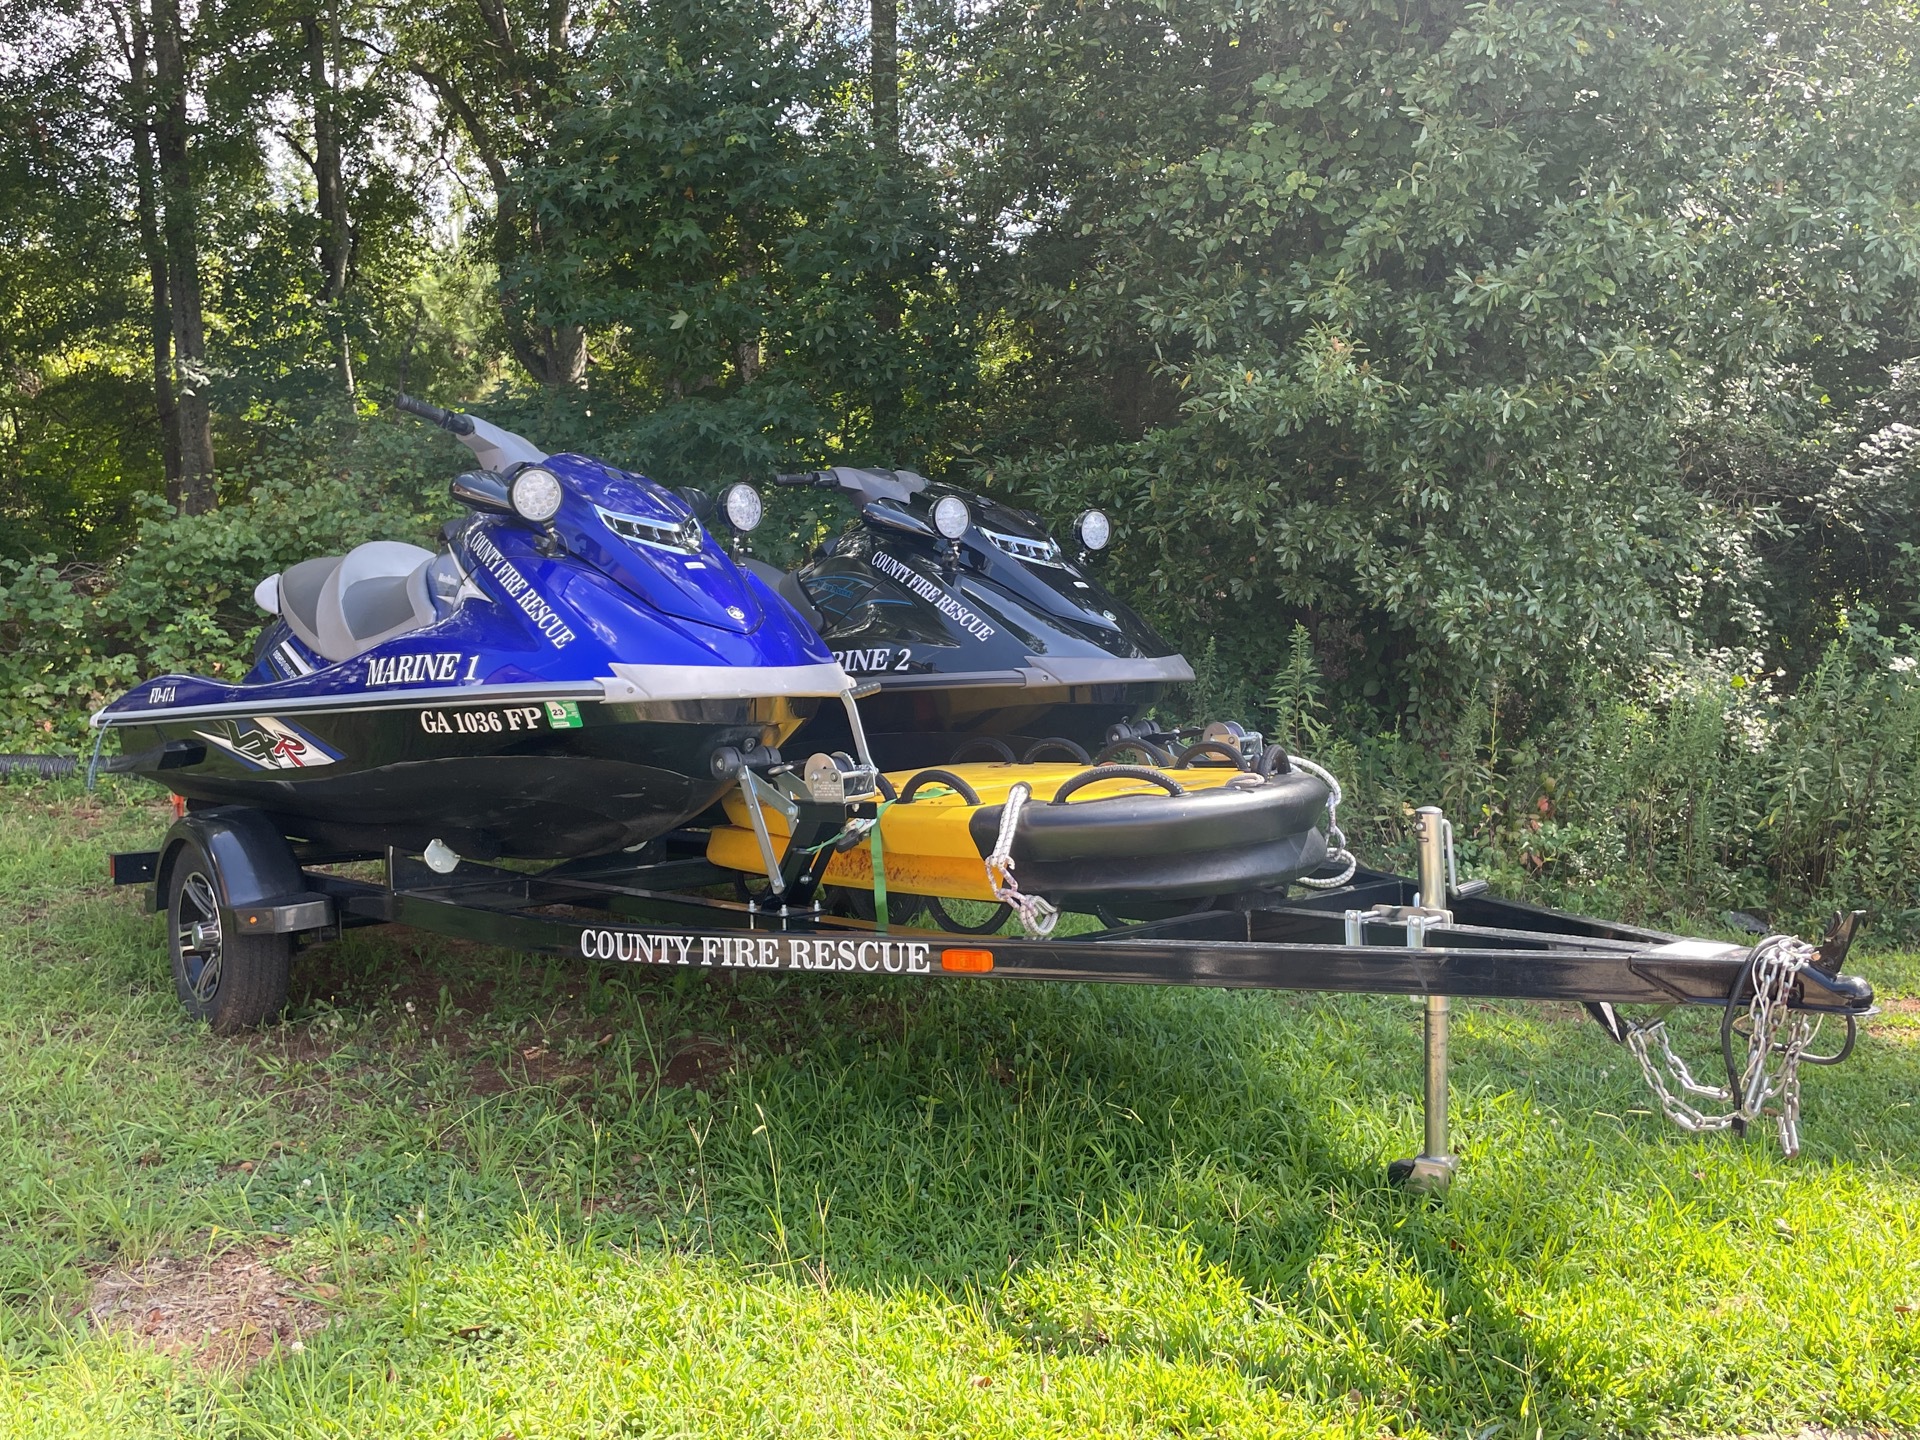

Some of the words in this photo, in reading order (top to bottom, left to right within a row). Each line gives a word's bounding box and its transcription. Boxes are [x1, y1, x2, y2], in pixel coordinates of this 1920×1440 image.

[470, 530, 507, 572] COUNTY
[494, 560, 530, 598] FIRE
[516, 588, 576, 650] RESCUE
[871, 550, 915, 583] COUNTY
[906, 572, 943, 603] FIRE
[934, 593, 996, 642] RESCUE
[365, 653, 461, 687] MARINE
[463, 654, 481, 681] 1
[832, 648, 891, 672] RINE
[894, 648, 911, 671] 2
[420, 710, 453, 734] GA
[452, 712, 503, 734] 1036
[503, 707, 542, 731] FP
[580, 929, 694, 965] COUNTY
[700, 936, 780, 968] FIRE
[788, 939, 931, 973] RESCUE
